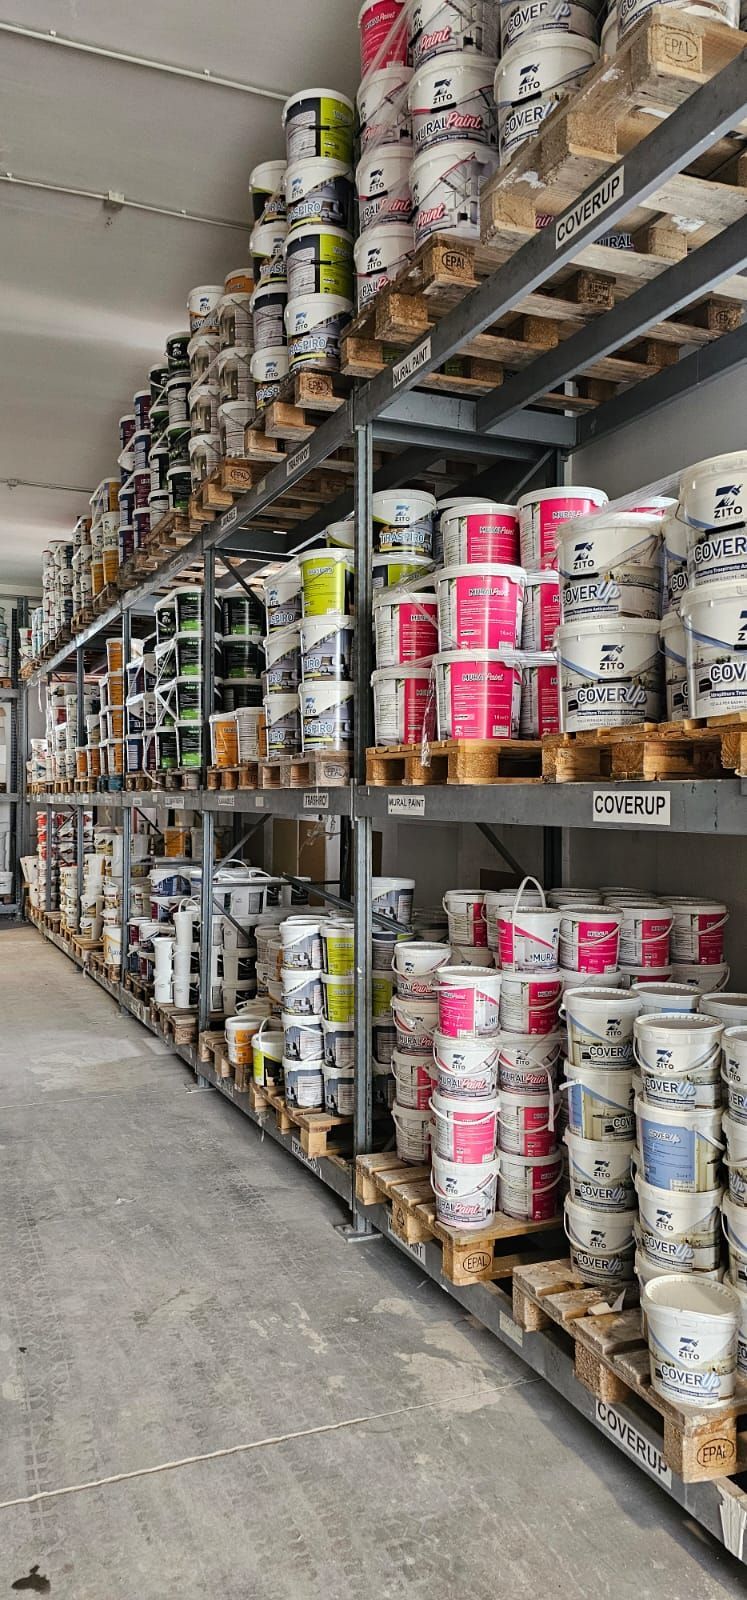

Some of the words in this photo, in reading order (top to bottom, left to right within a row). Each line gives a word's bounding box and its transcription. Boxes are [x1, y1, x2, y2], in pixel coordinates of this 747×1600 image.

[518, 81, 541, 96] ZITO
[433, 93, 453, 105] ZITO
[557, 175, 621, 243] COVERUP
[411, 346, 429, 372] PAINT
[394, 515, 410, 523] ZITO
[713, 506, 743, 525] ZITO
[573, 559, 595, 572] ZITO
[599, 661, 625, 673] ZITO
[389, 798, 407, 807] MURAL
[408, 798, 424, 808] PAINT
[594, 795, 666, 815] COVERUP
[656, 1063, 675, 1073] ZITO
[593, 1171, 611, 1179] ZITO
[655, 1222, 674, 1231] ZITO
[589, 1241, 607, 1250] ZITO
[467, 1256, 488, 1269] EPAL
[678, 1350, 700, 1360] ZITO
[702, 1446, 728, 1463] EPAL
